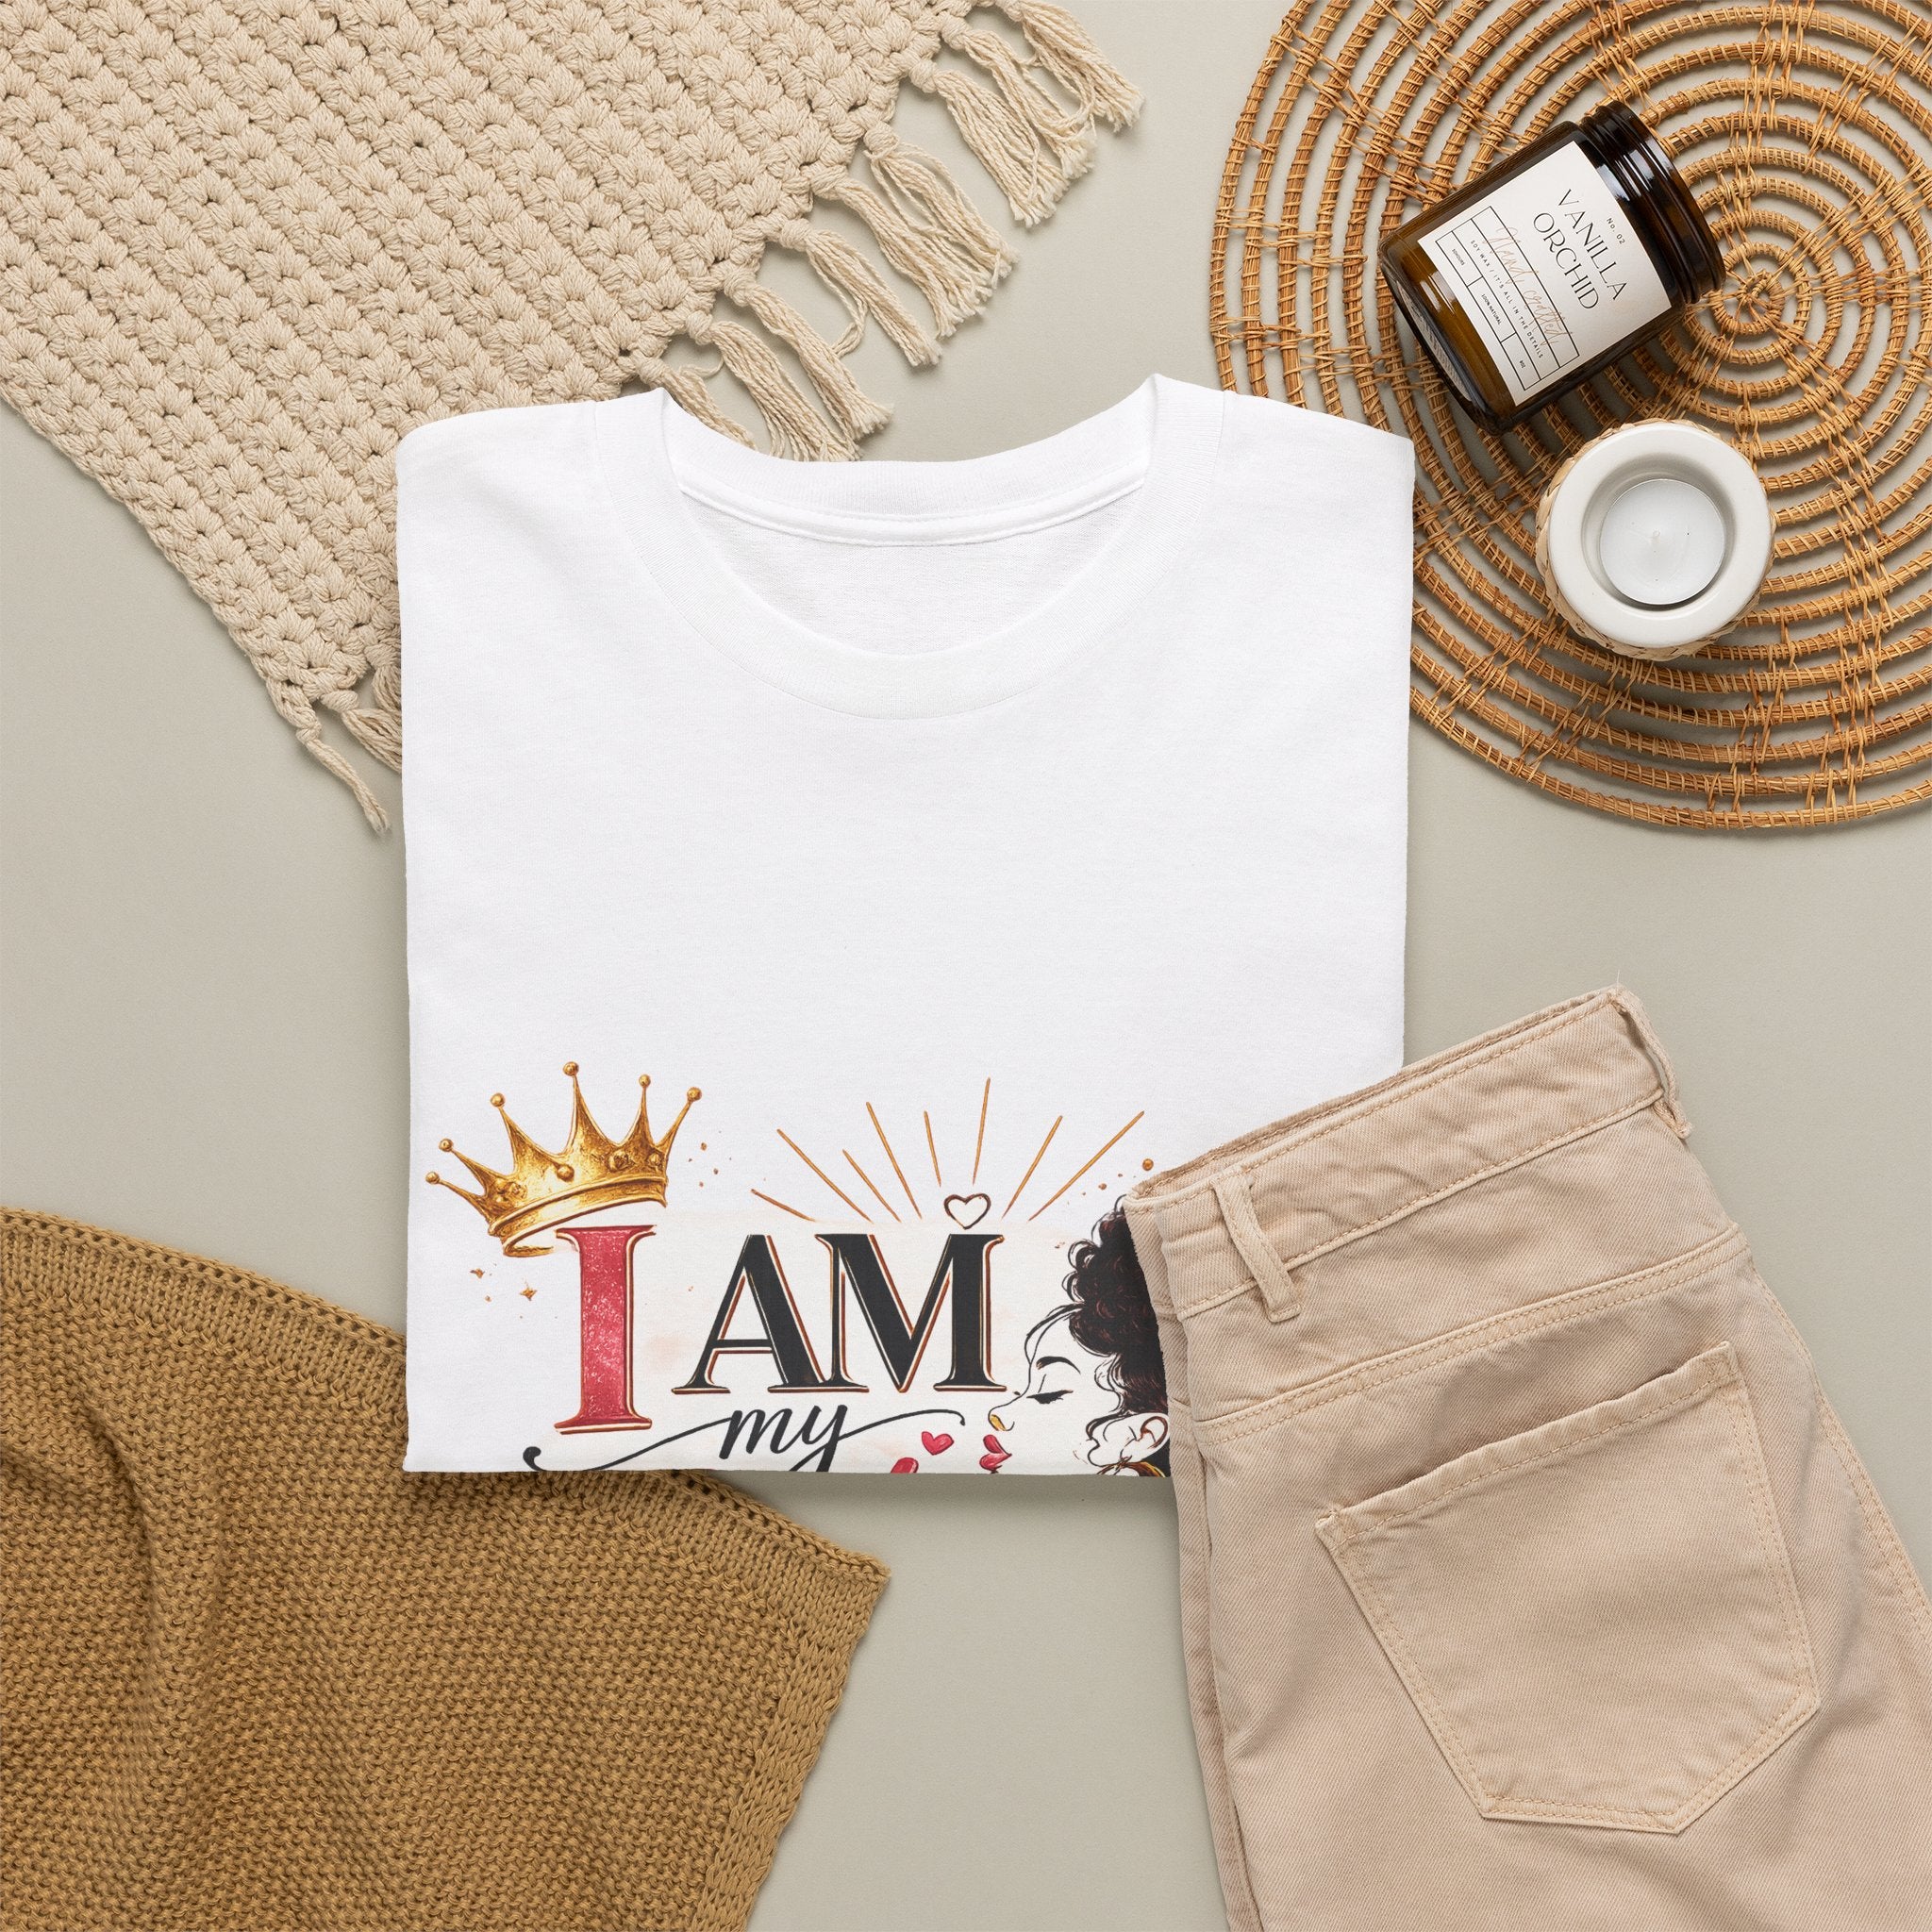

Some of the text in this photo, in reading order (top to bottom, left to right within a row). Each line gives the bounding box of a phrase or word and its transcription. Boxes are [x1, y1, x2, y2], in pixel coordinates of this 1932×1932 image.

[1532, 211, 1600, 310] ORCHID
[1557, 189, 1627, 301] VANILLA
[1606, 217, 1625, 245] No. 02
[1470, 240, 1480, 252] SOY
[1479, 254, 1491, 267] WAX
[1493, 275, 1505, 289] IT'S
[1504, 291, 1513, 305] ALL
[1512, 307, 1520, 315] IN
[1520, 316, 1528, 330] THE
[1526, 331, 1543, 358] DETAILS
[554, 1224, 1008, 1437] I AM
